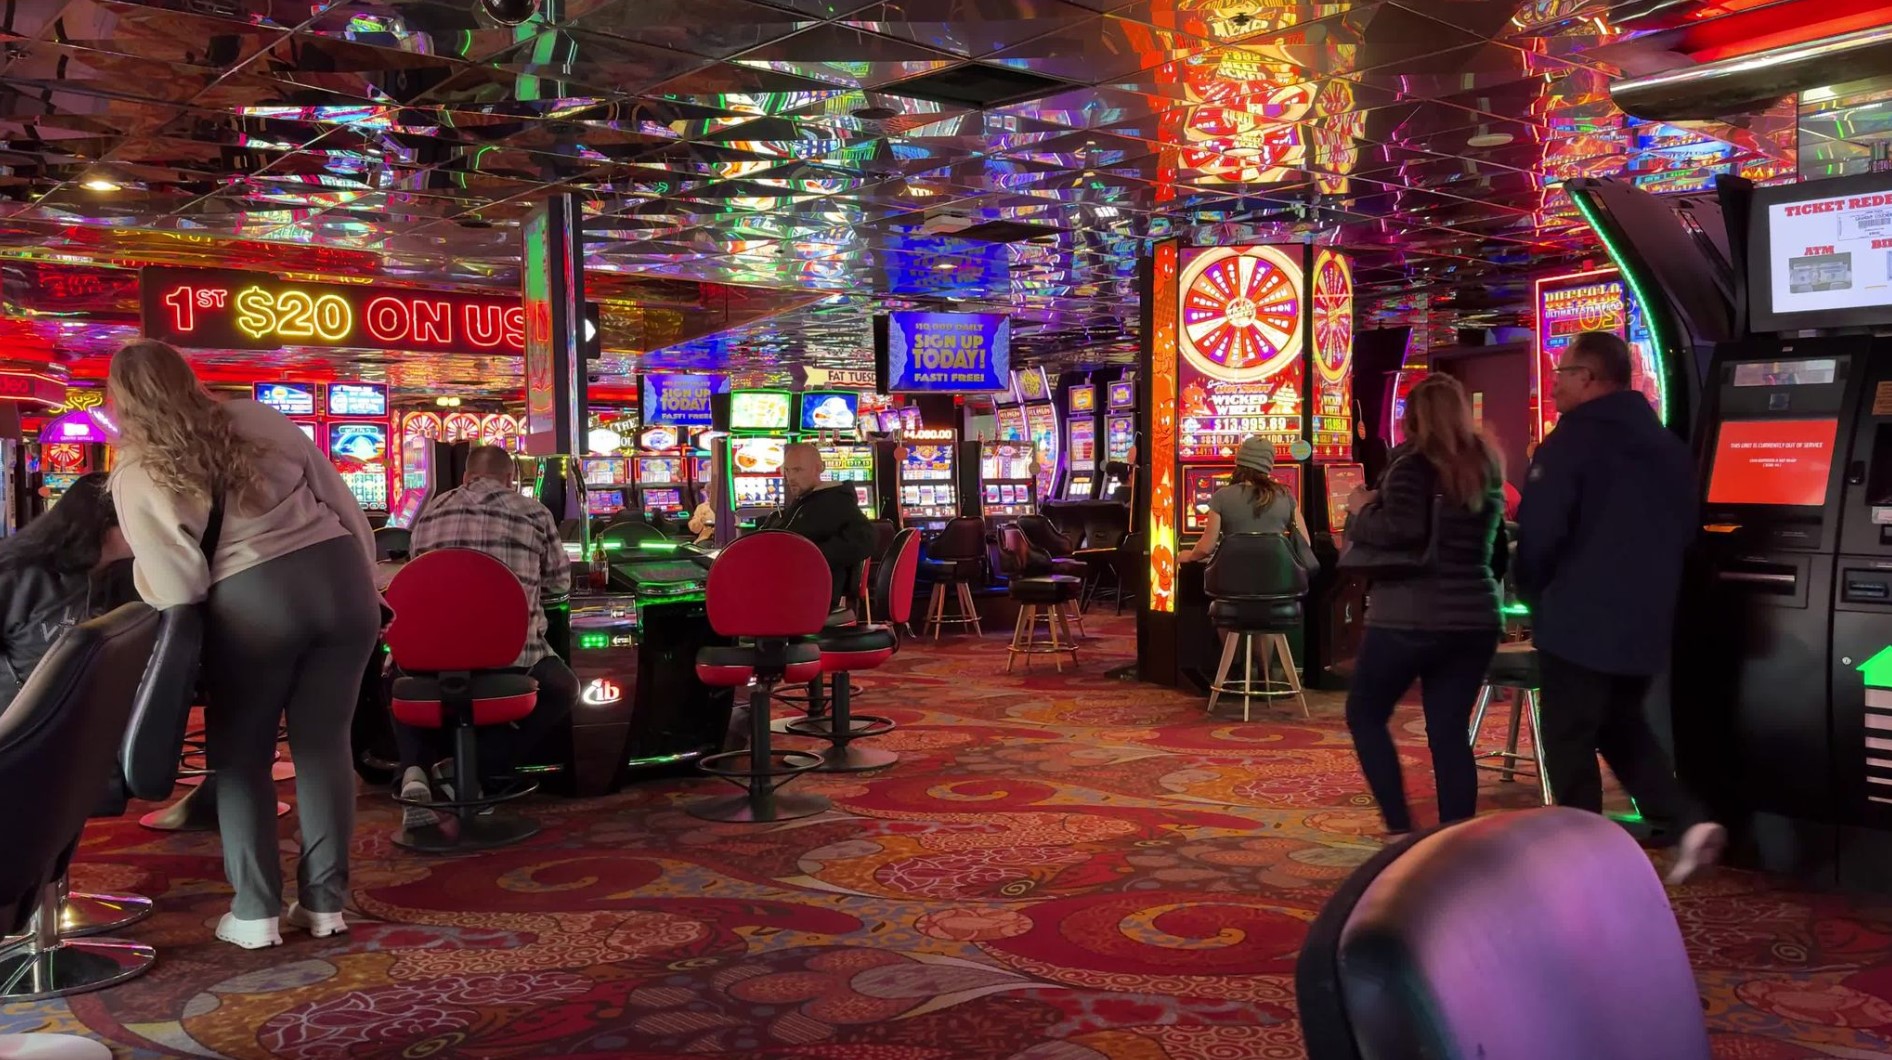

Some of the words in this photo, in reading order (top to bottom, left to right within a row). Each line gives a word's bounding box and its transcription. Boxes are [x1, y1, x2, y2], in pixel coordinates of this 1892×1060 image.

[1785, 200, 1845, 217] TICKET
[1804, 245, 1834, 256] ATM
[237, 286, 352, 341] $20
[367, 297, 452, 343] ON
[914, 334, 957, 348] SIGN
[961, 335, 984, 349] UP
[912, 349, 986, 369] TODAY!
[828, 371, 845, 381] FAT
[914, 373, 948, 382] FAST!
[951, 374, 984, 382] FREE!
[661, 388, 692, 398] SIGN
[695, 389, 711, 398] UP
[661, 398, 708, 410] TODAY
[1211, 394, 1268, 405] WICKED
[1216, 405, 1265, 416] WHEEL
[614, 419, 637, 433] THE
